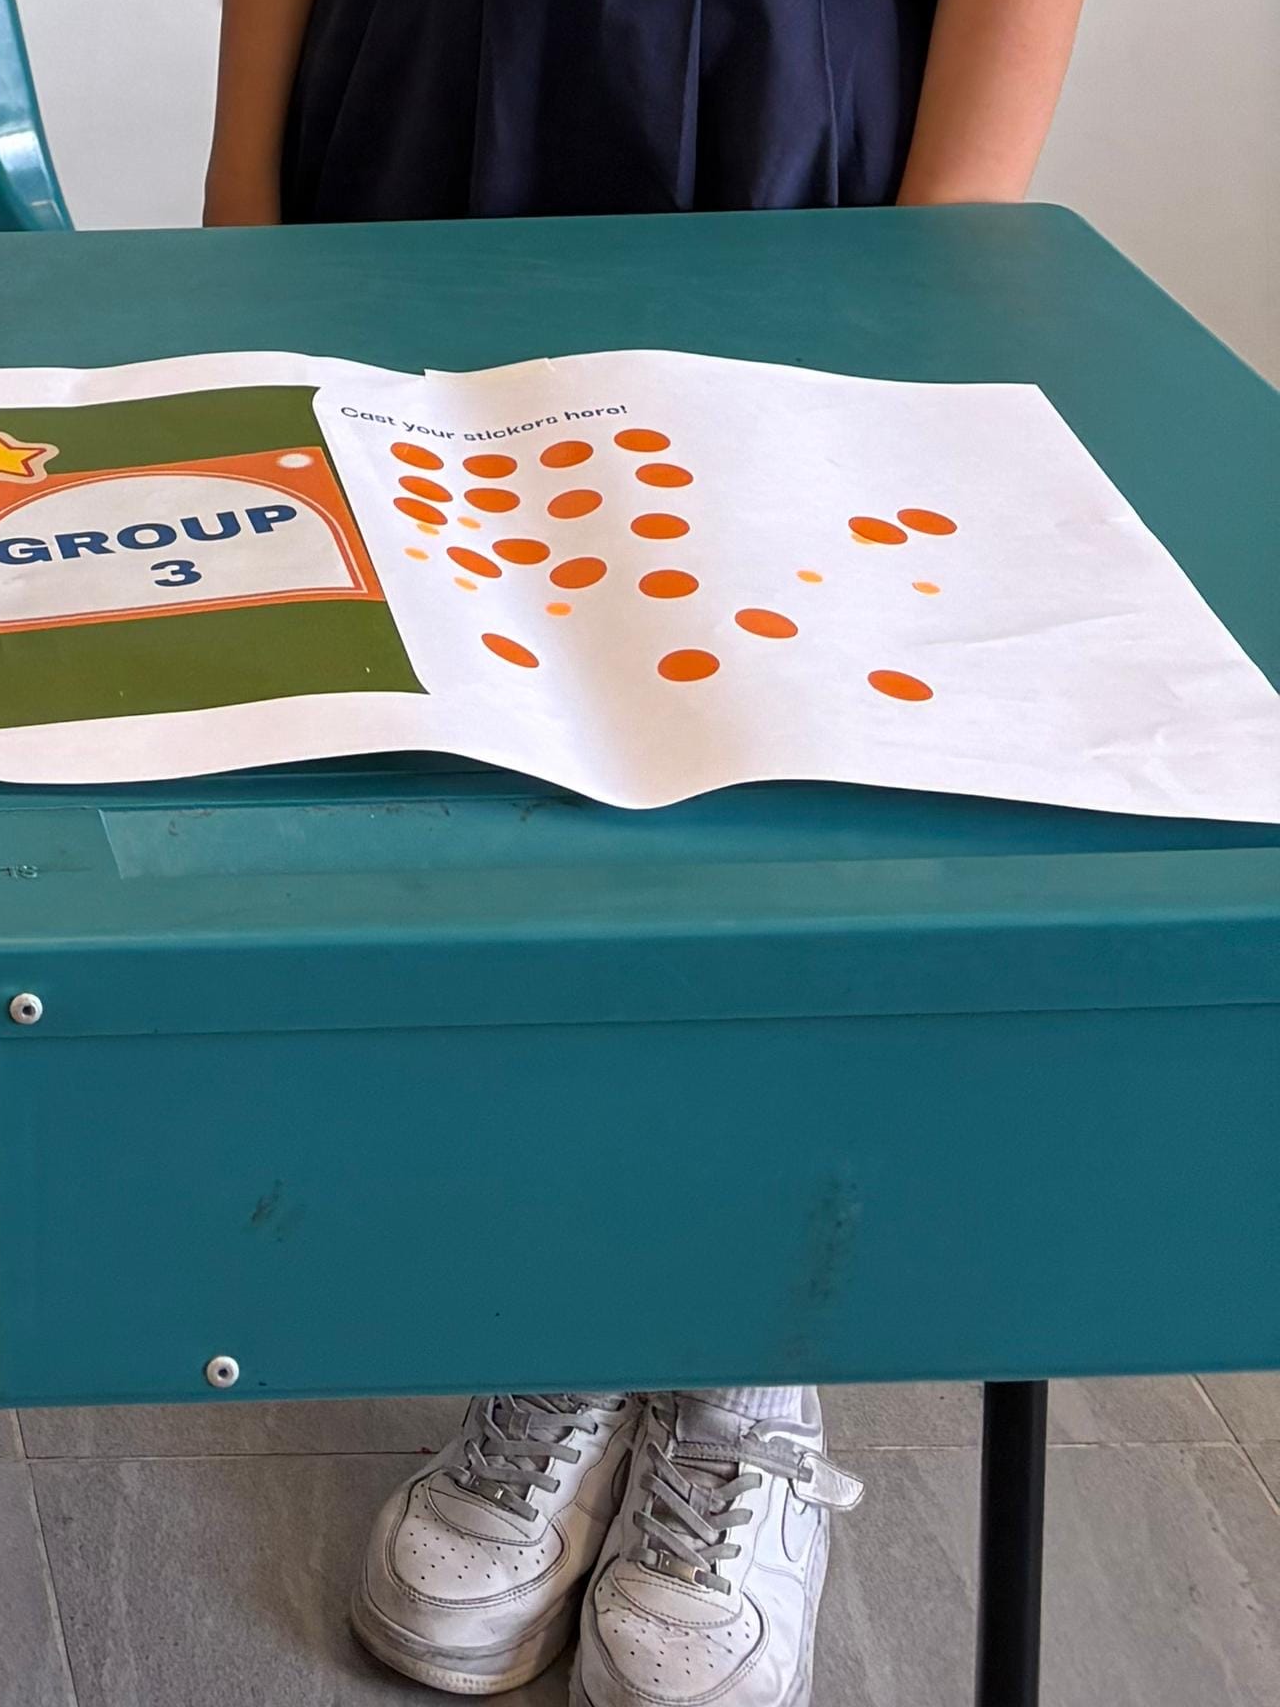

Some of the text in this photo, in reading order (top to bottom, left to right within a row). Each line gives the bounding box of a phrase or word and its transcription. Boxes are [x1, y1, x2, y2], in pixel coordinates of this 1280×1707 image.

[341, 404, 628, 441] Cast your stickers here!
[150, 559, 202, 588] 3
